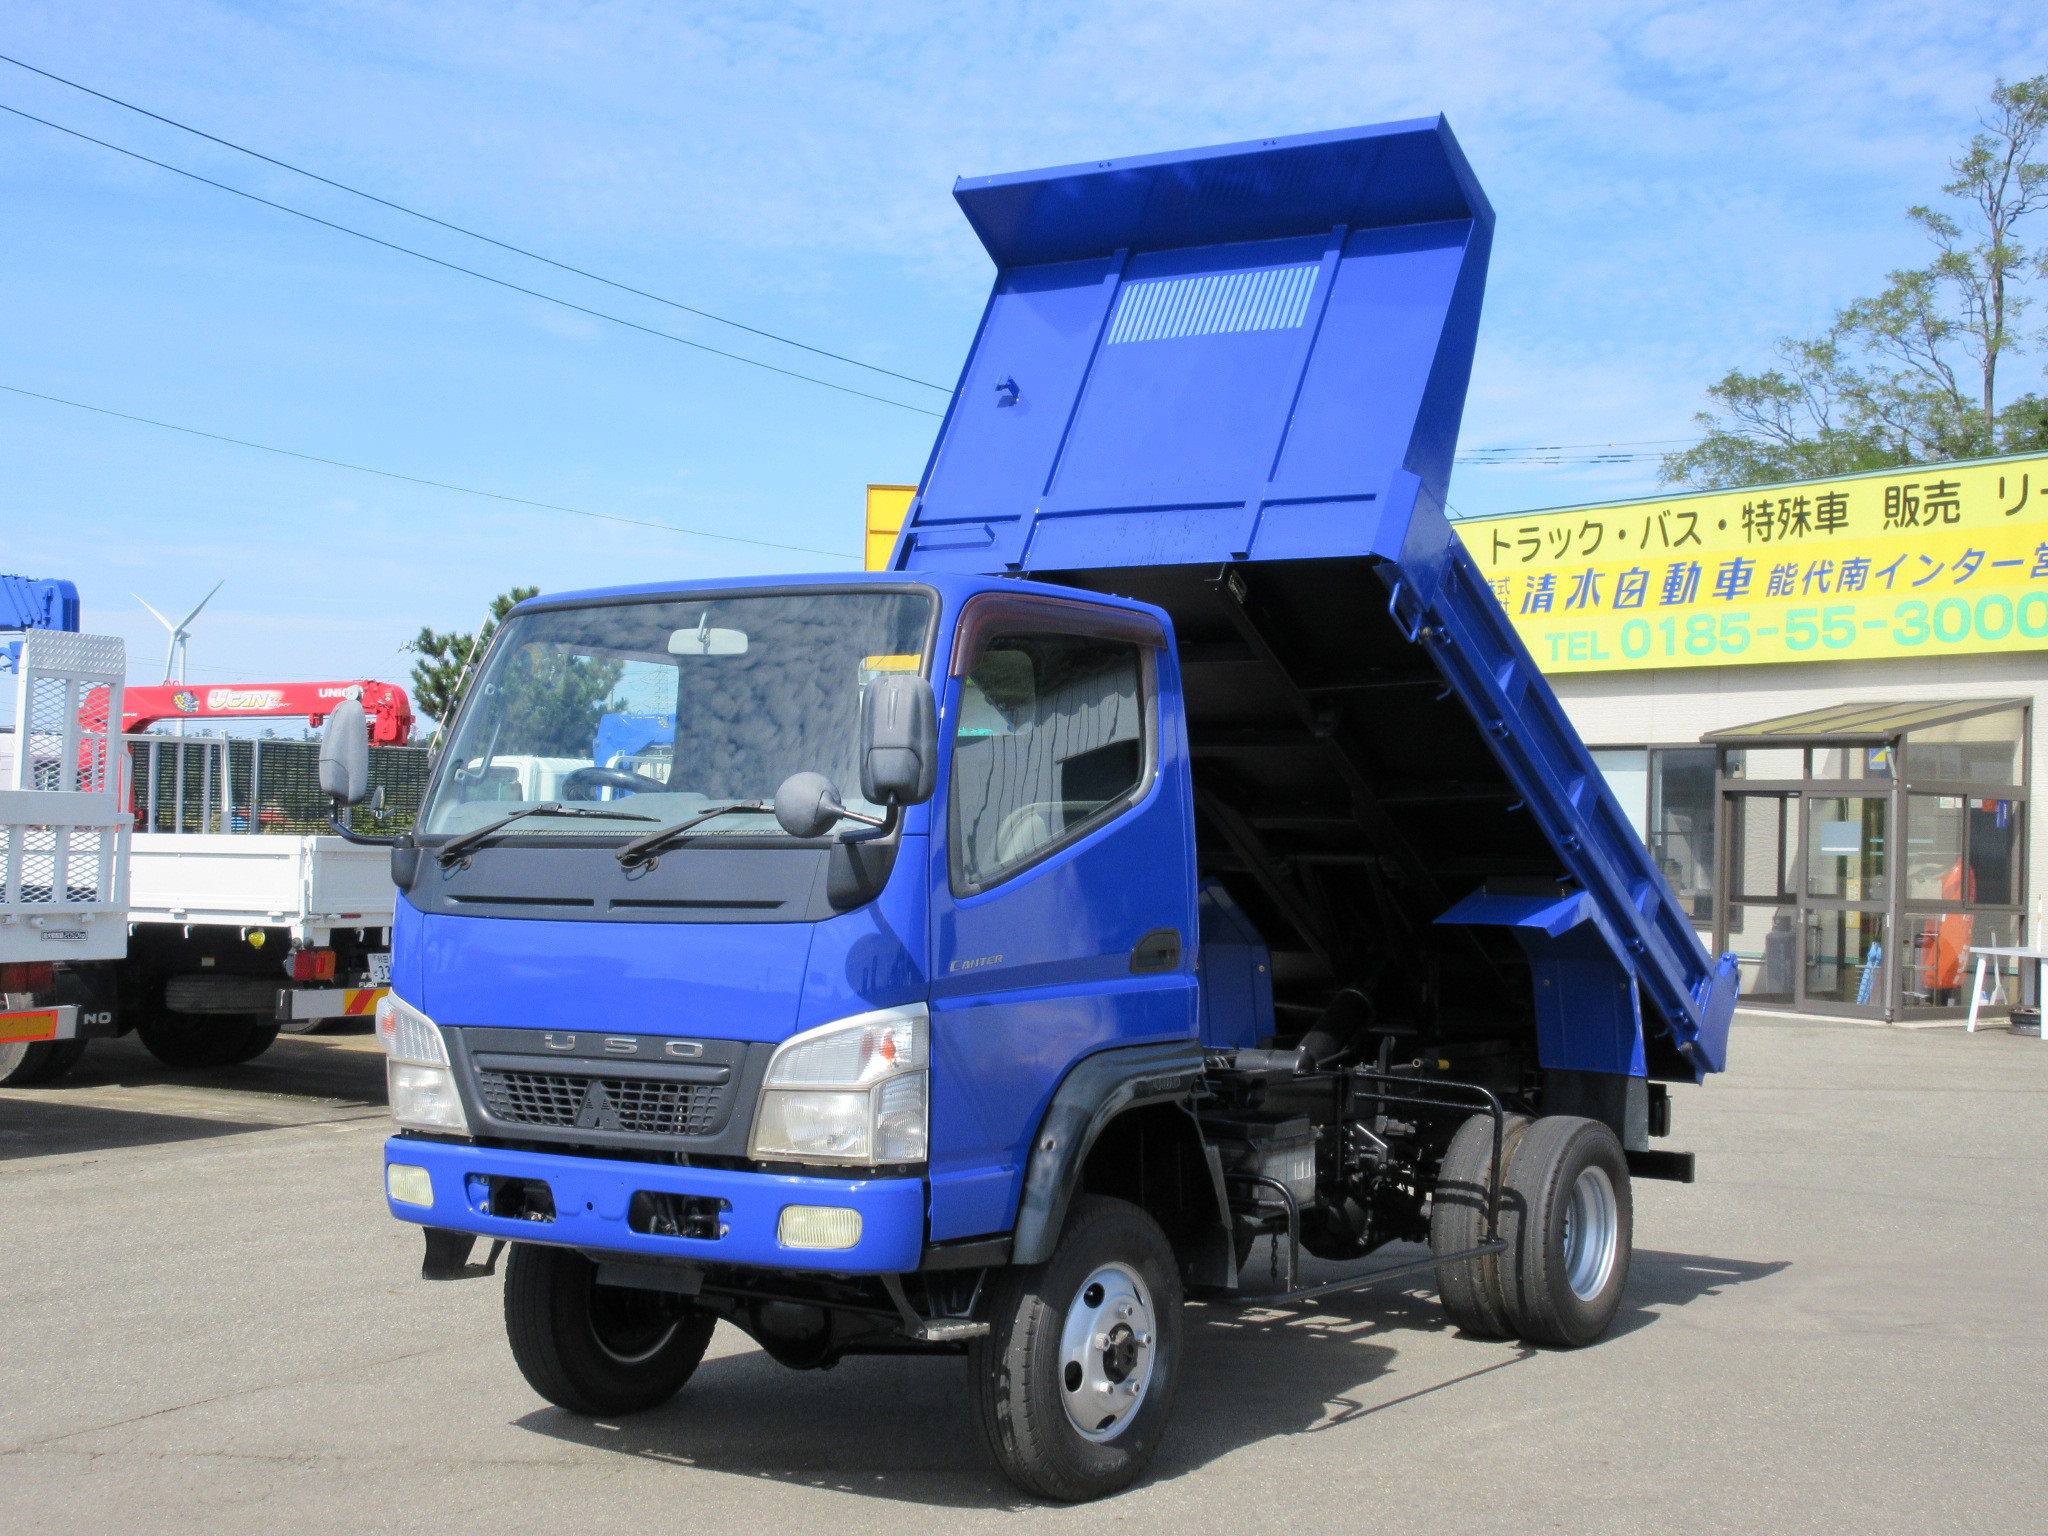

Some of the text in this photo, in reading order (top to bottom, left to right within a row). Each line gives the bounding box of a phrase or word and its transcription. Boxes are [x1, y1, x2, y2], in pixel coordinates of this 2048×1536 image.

[1492, 473, 2048, 565] トラック・バス・特殊車 販売 リ
[1519, 556, 1757, 615] 清水自動車
[1544, 592, 2048, 662] TEL 0185-55-3000
[949, 954, 1004, 972] CANTER
[544, 1033, 703, 1058] USO
